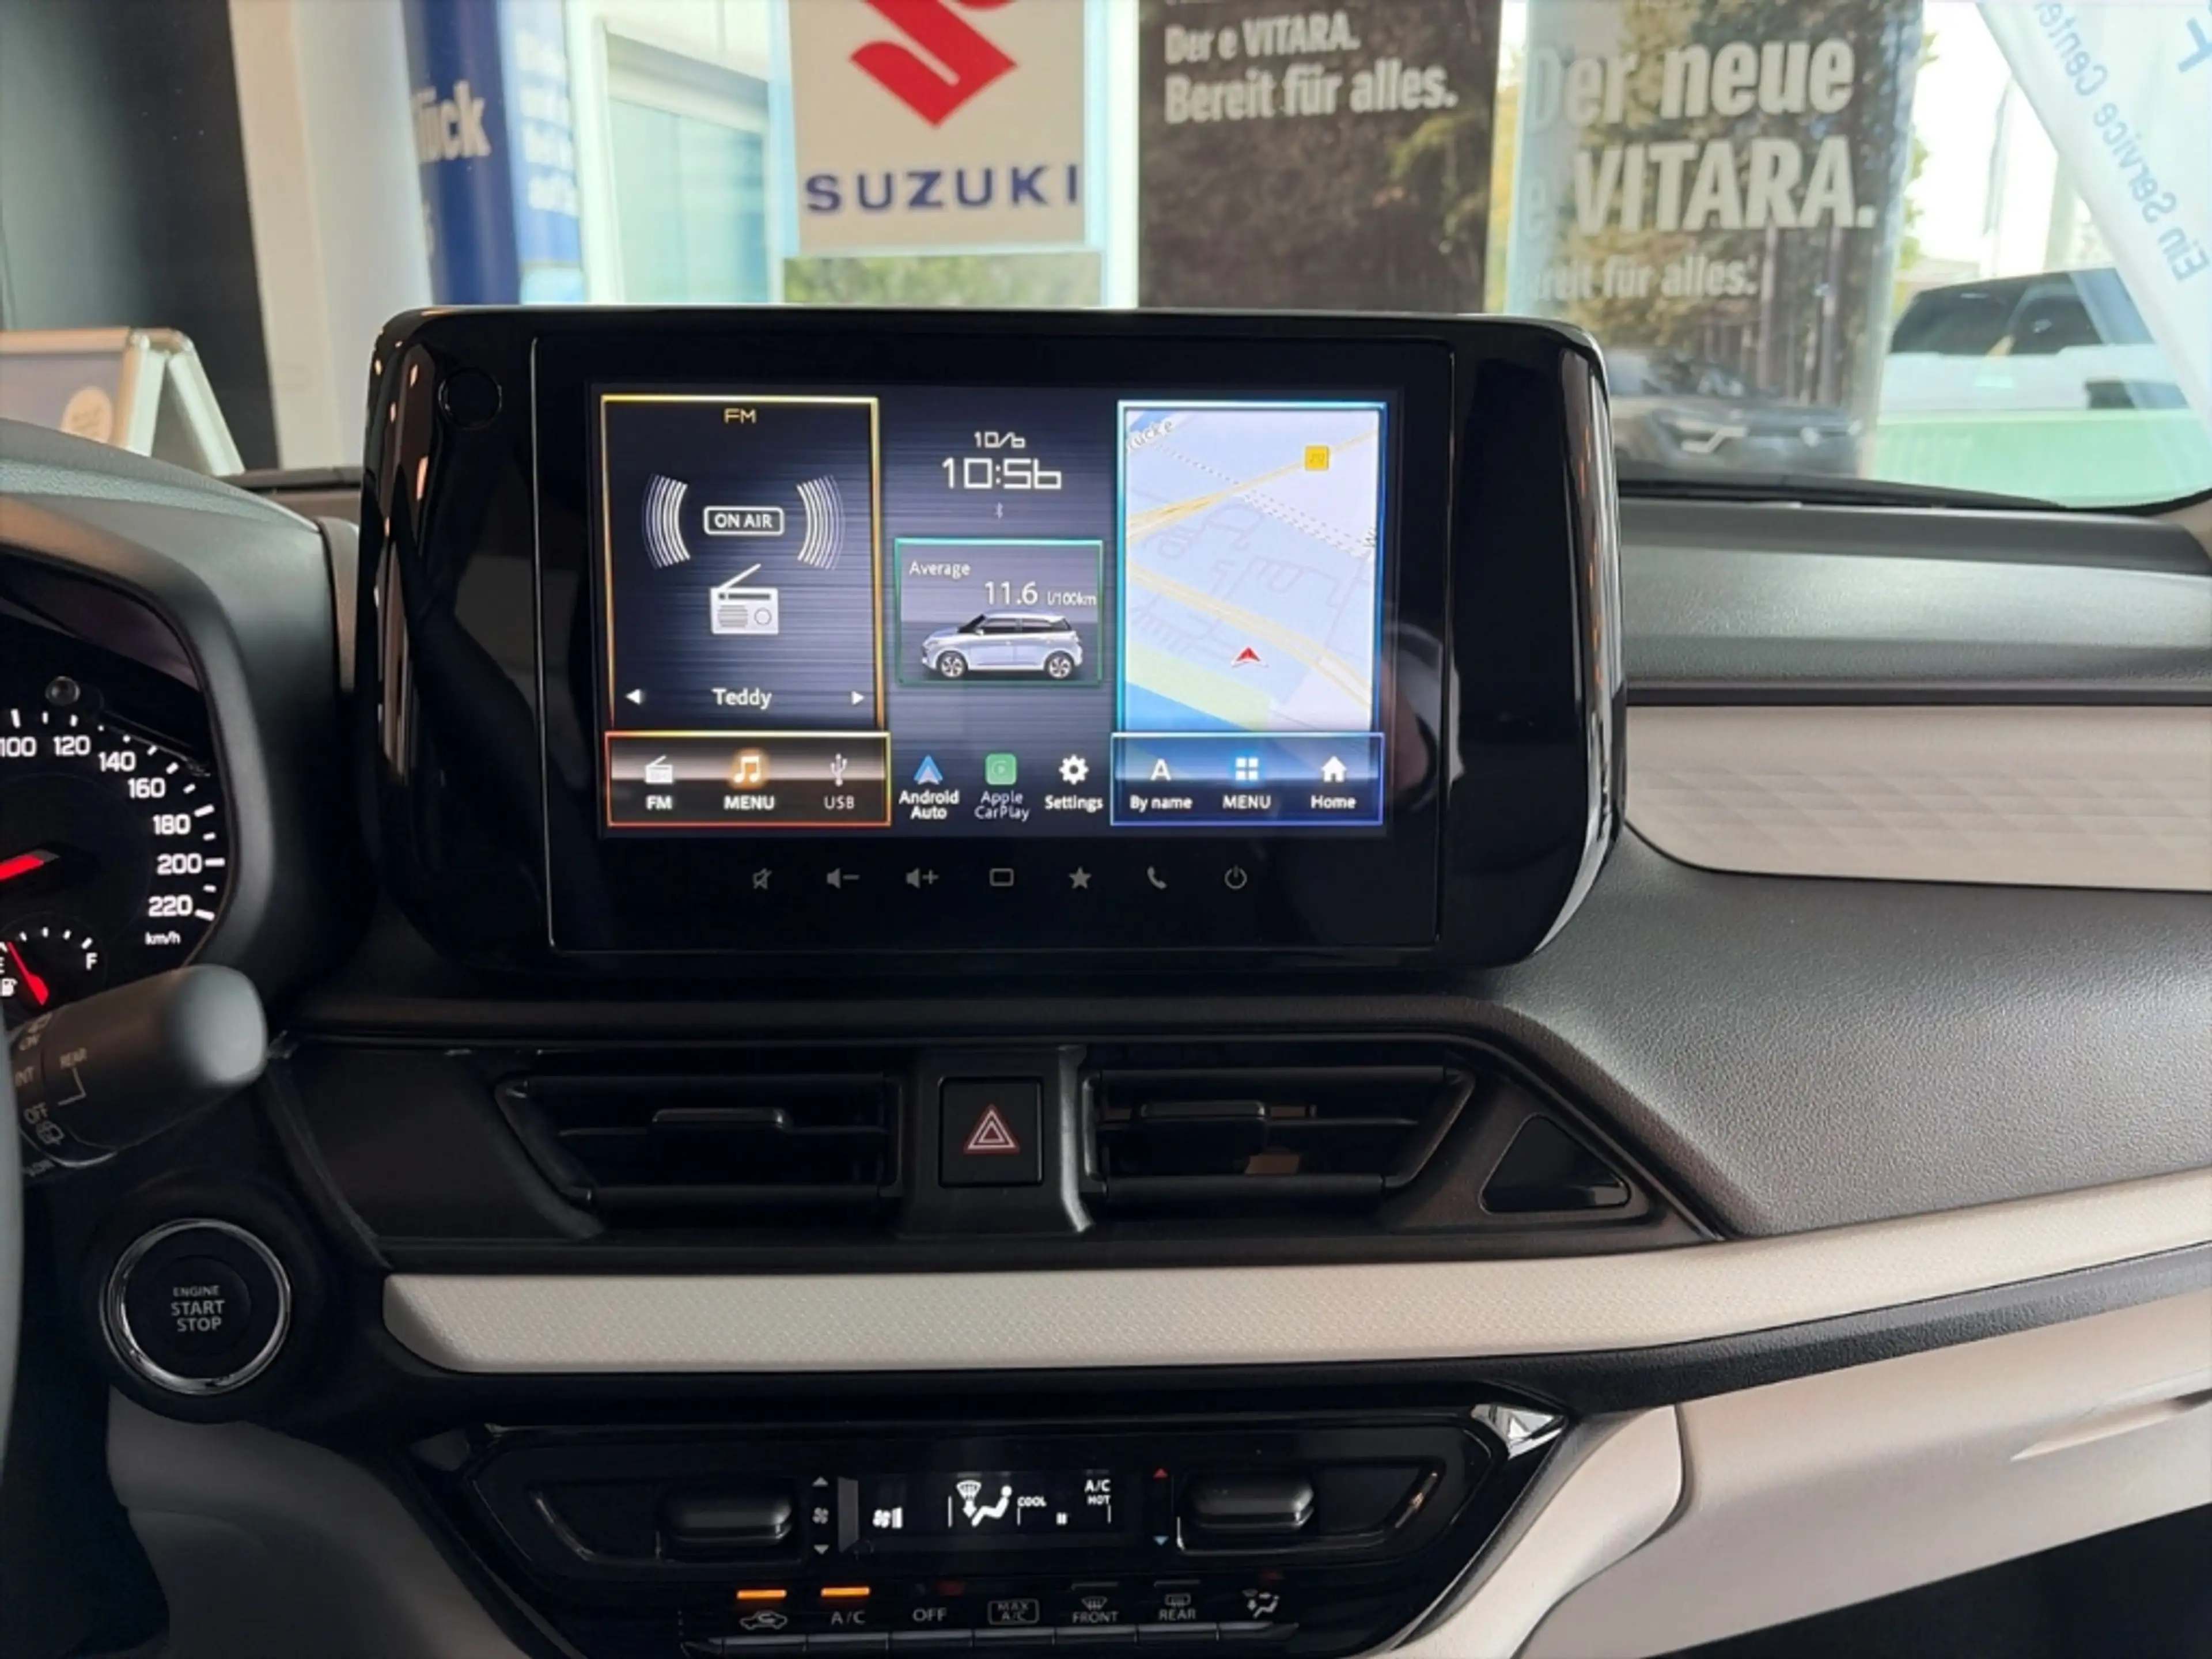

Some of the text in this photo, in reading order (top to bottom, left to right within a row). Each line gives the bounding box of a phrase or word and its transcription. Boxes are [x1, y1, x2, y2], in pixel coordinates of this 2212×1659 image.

[1165, 9, 1361, 65] Der e VITARA.
[1165, 57, 1459, 124] Bereit für alles.
[1525, 37, 1855, 132] Der neue
[805, 164, 1077, 213] SUZUKI
[1574, 135, 1877, 237] VITARA.
[1603, 253, 1655, 300] für
[1660, 252, 1758, 298] alles.
[724, 408, 757, 424] FM
[942, 457, 1062, 490] 10:56
[714, 514, 773, 528] ON AIR
[909, 560, 971, 579] Average
[984, 581, 1038, 605] 11.6
[712, 688, 772, 710] Teddy
[0, 736, 37, 758] 100
[54, 735, 91, 757] 120
[99, 752, 136, 772] 140
[128, 778, 166, 798] 160
[646, 796, 673, 810] FM
[724, 796, 775, 810] MENU
[824, 796, 855, 809] USB
[899, 789, 960, 805] Android
[980, 790, 1023, 806] Apple
[1044, 795, 1104, 813] Settings
[1130, 795, 1193, 812] By name
[1222, 795, 1272, 809] MENU
[1310, 796, 1357, 809] Home
[910, 806, 948, 820] Auto
[974, 806, 1030, 822] CarPlay
[153, 814, 191, 835] 180
[157, 854, 203, 875] 200
[149, 895, 193, 917] 220
[145, 931, 181, 945] km/h
[86, 953, 97, 970] F
[23, 1102, 48, 1125] OFF
[173, 1285, 220, 1297] ENGINE
[171, 1300, 226, 1316] START
[177, 1317, 222, 1332] STOP
[1085, 1479, 1111, 1492] A/C
[1017, 1497, 1047, 1507] COOL
[1087, 1494, 1111, 1505] HOT
[998, 1601, 1028, 1611] MAX
[831, 1611, 866, 1625] A/C
[912, 1608, 947, 1622] OFF
[1001, 1611, 1025, 1621] A/C
[1072, 1611, 1118, 1623] FRONT
[1158, 1609, 1196, 1620] REAR
